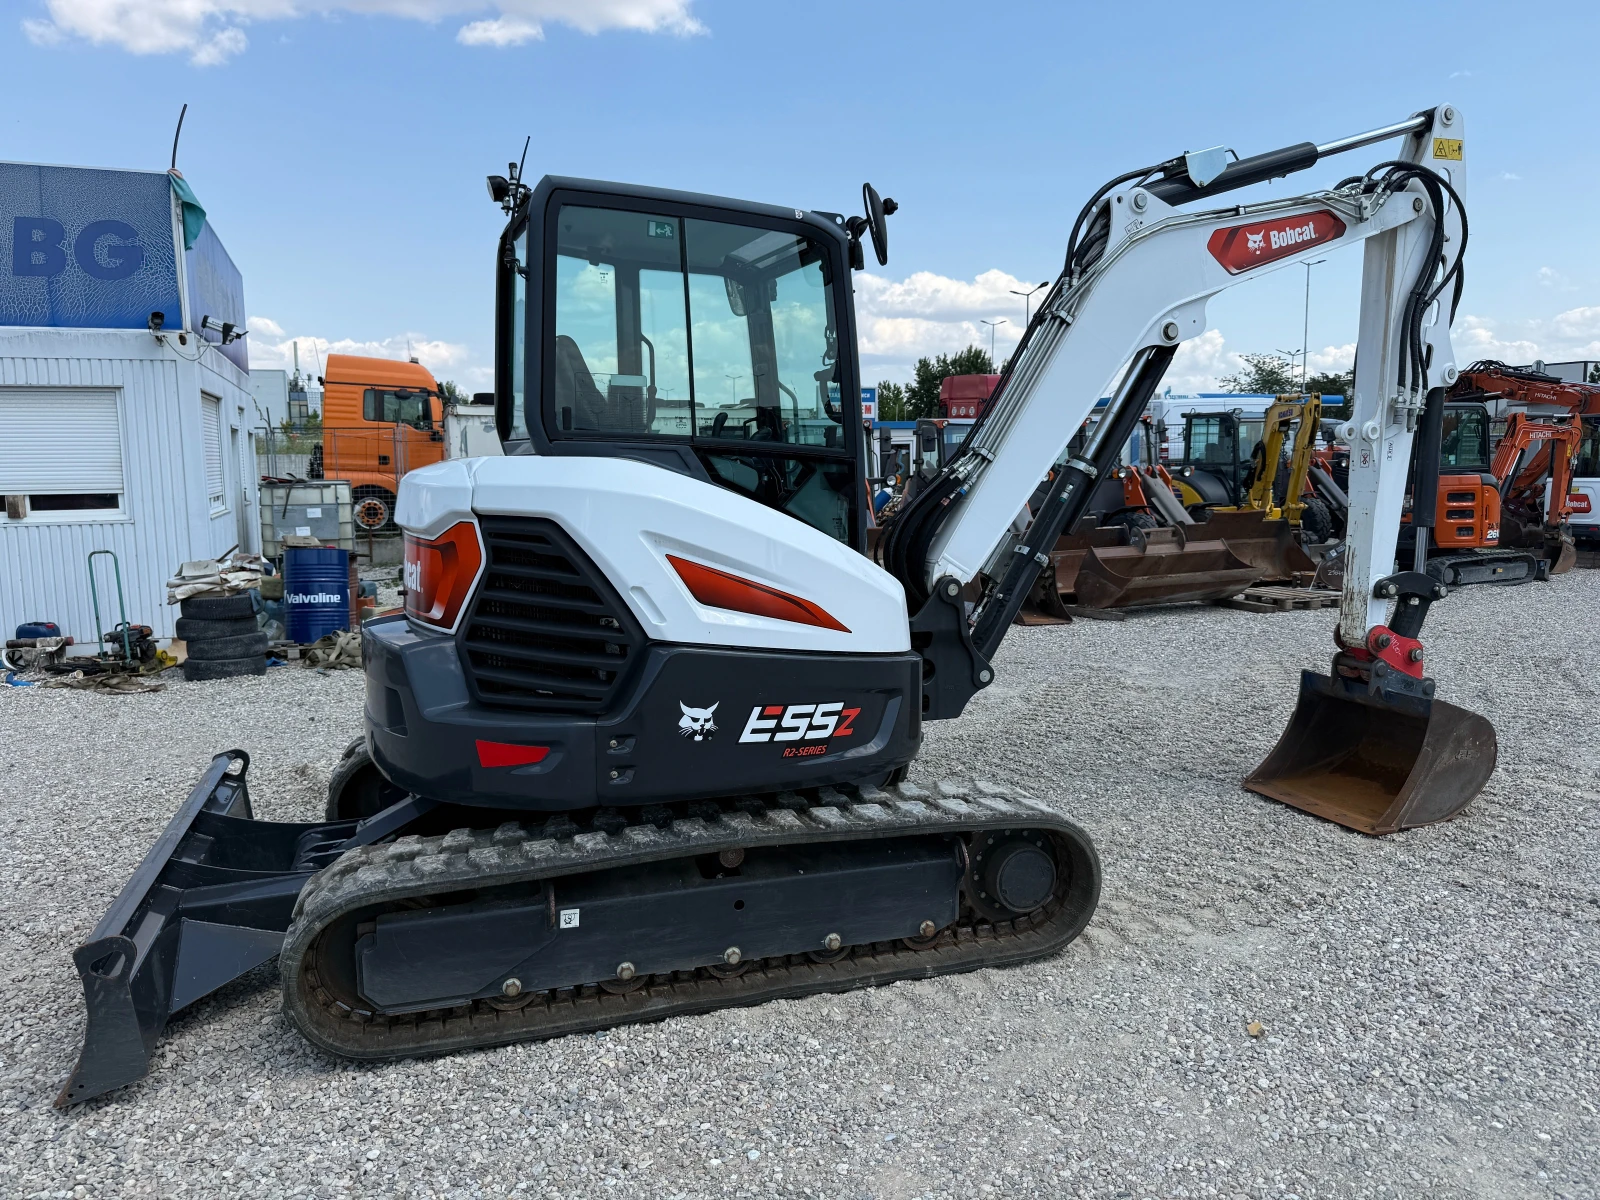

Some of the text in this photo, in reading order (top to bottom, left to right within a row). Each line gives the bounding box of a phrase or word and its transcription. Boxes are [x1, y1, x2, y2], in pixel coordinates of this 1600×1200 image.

[1270, 221, 1315, 249] Bobcat
[12, 216, 143, 281] BG
[1534, 392, 1557, 400] HITACHI
[1530, 431, 1551, 439] HITACHI
[1565, 495, 1588, 508] Bobcat
[286, 593, 341, 604] Valvoline
[783, 745, 827, 757] R2-SERIES
